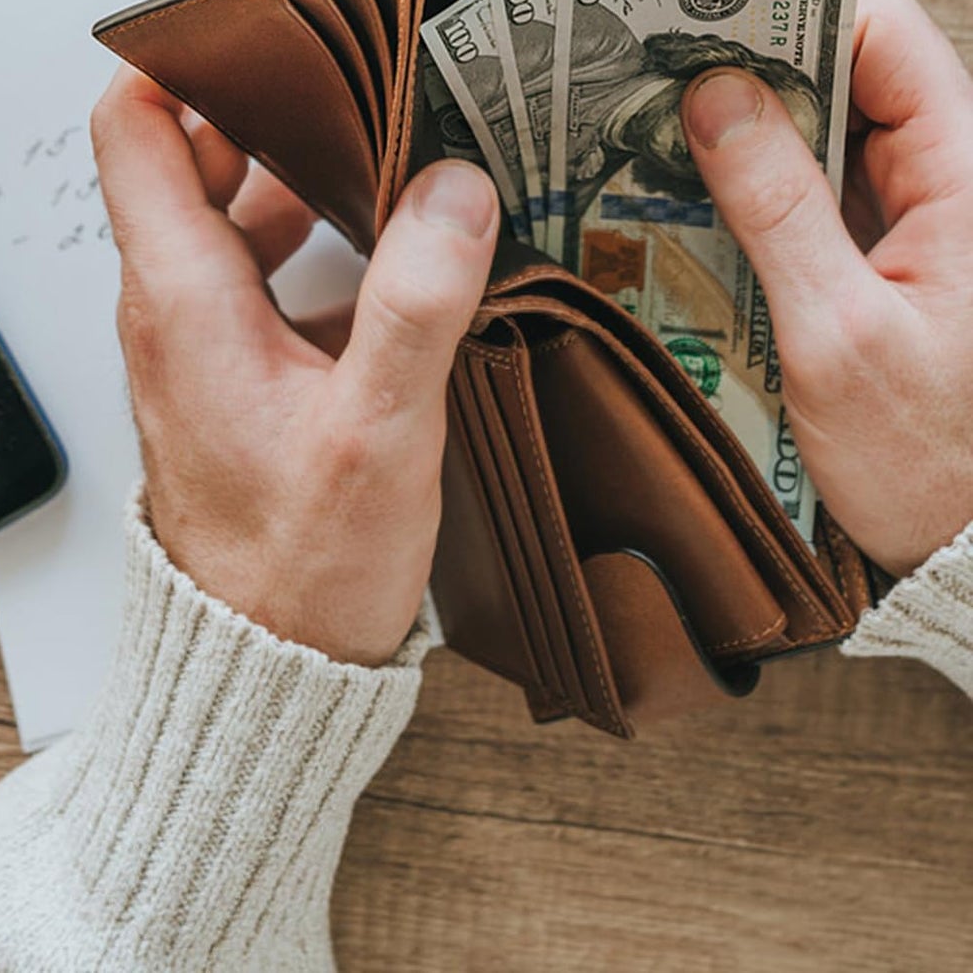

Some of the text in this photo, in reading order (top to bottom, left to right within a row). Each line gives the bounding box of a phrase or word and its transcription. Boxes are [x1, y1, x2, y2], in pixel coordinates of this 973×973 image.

[443, 18, 479, 64] 100
[770, 36, 788, 47] R
[794, 33, 806, 67] NOTE
